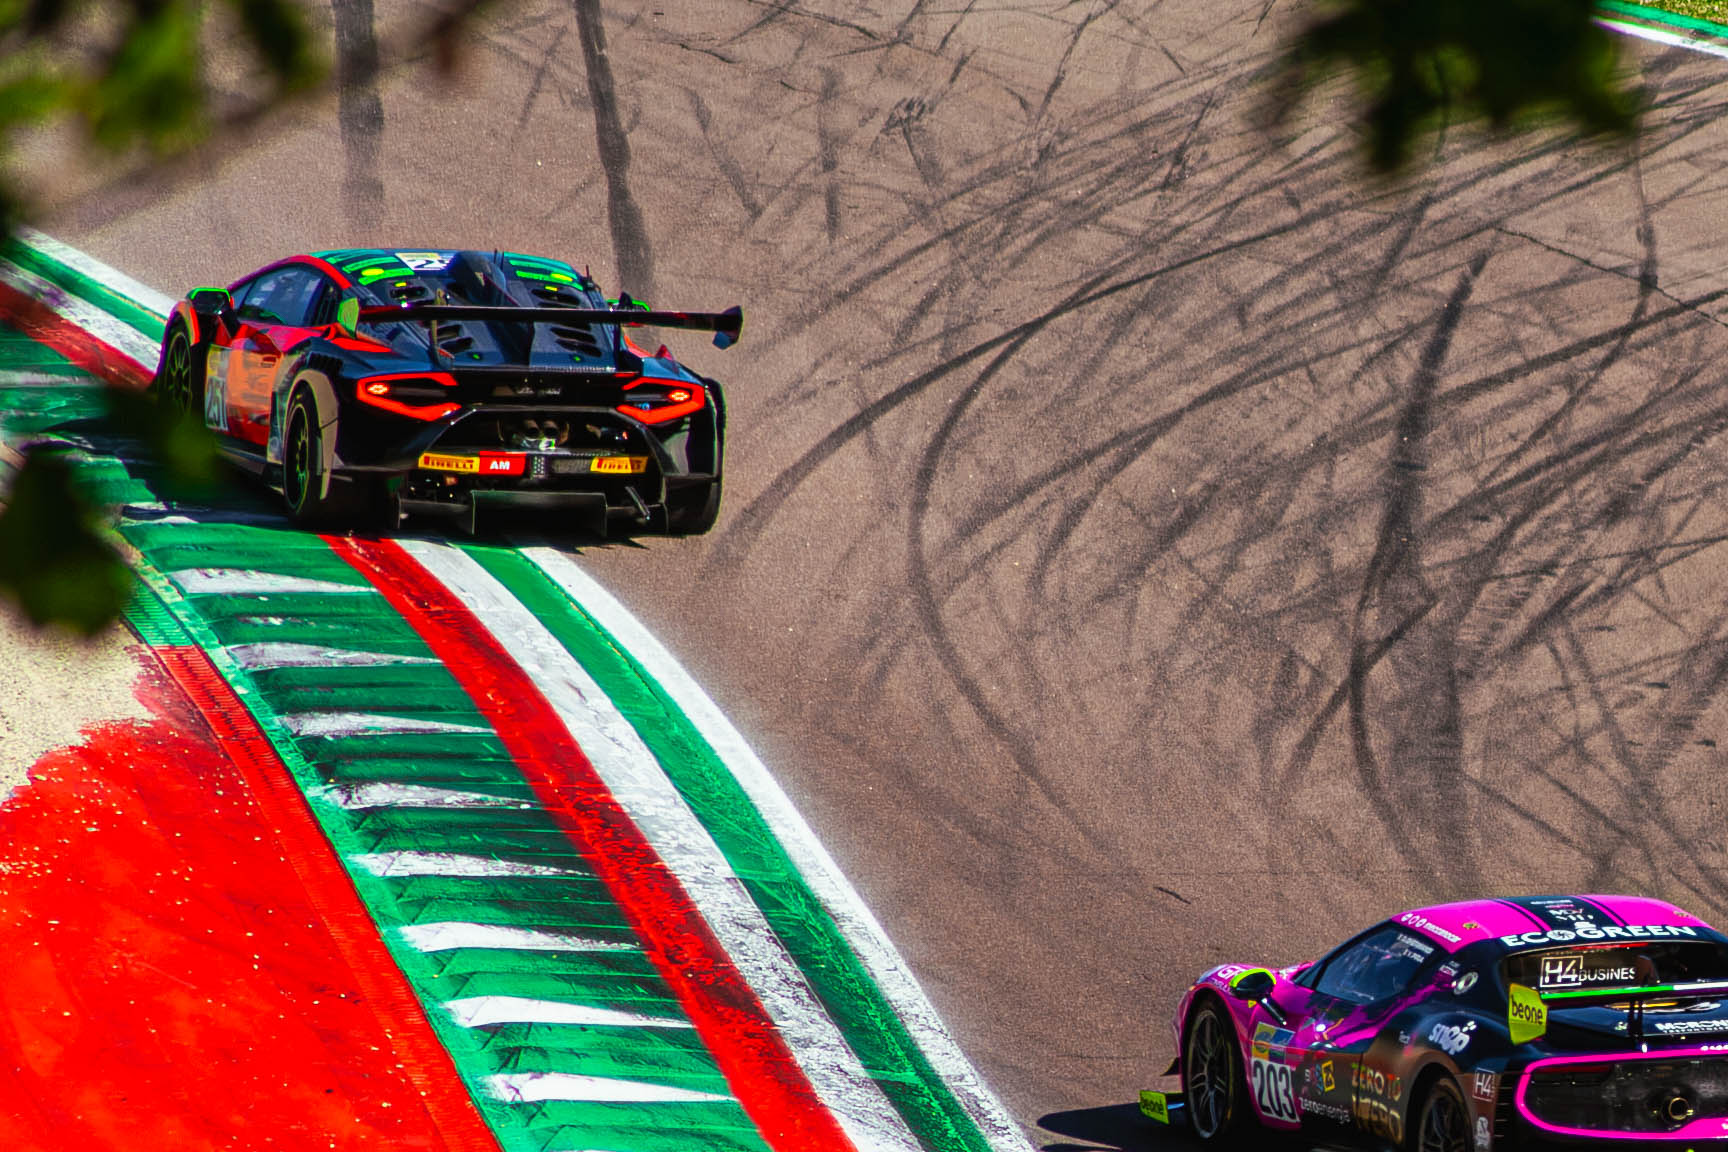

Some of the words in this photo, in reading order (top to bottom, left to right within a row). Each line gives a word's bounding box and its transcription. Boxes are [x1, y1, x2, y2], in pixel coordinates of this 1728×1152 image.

[424, 456, 474, 470] PIRELLI
[490, 461, 511, 470] AM
[597, 456, 642, 469] PIRELLI
[1500, 925, 1697, 947] ECOGREEN
[1544, 959, 1579, 984] H4
[1511, 994, 1544, 1025] beone
[1252, 1060, 1298, 1121] 203
[1352, 1062, 1386, 1096] ZERO
[1386, 1073, 1401, 1102] TO
[1475, 1073, 1492, 1097] H4
